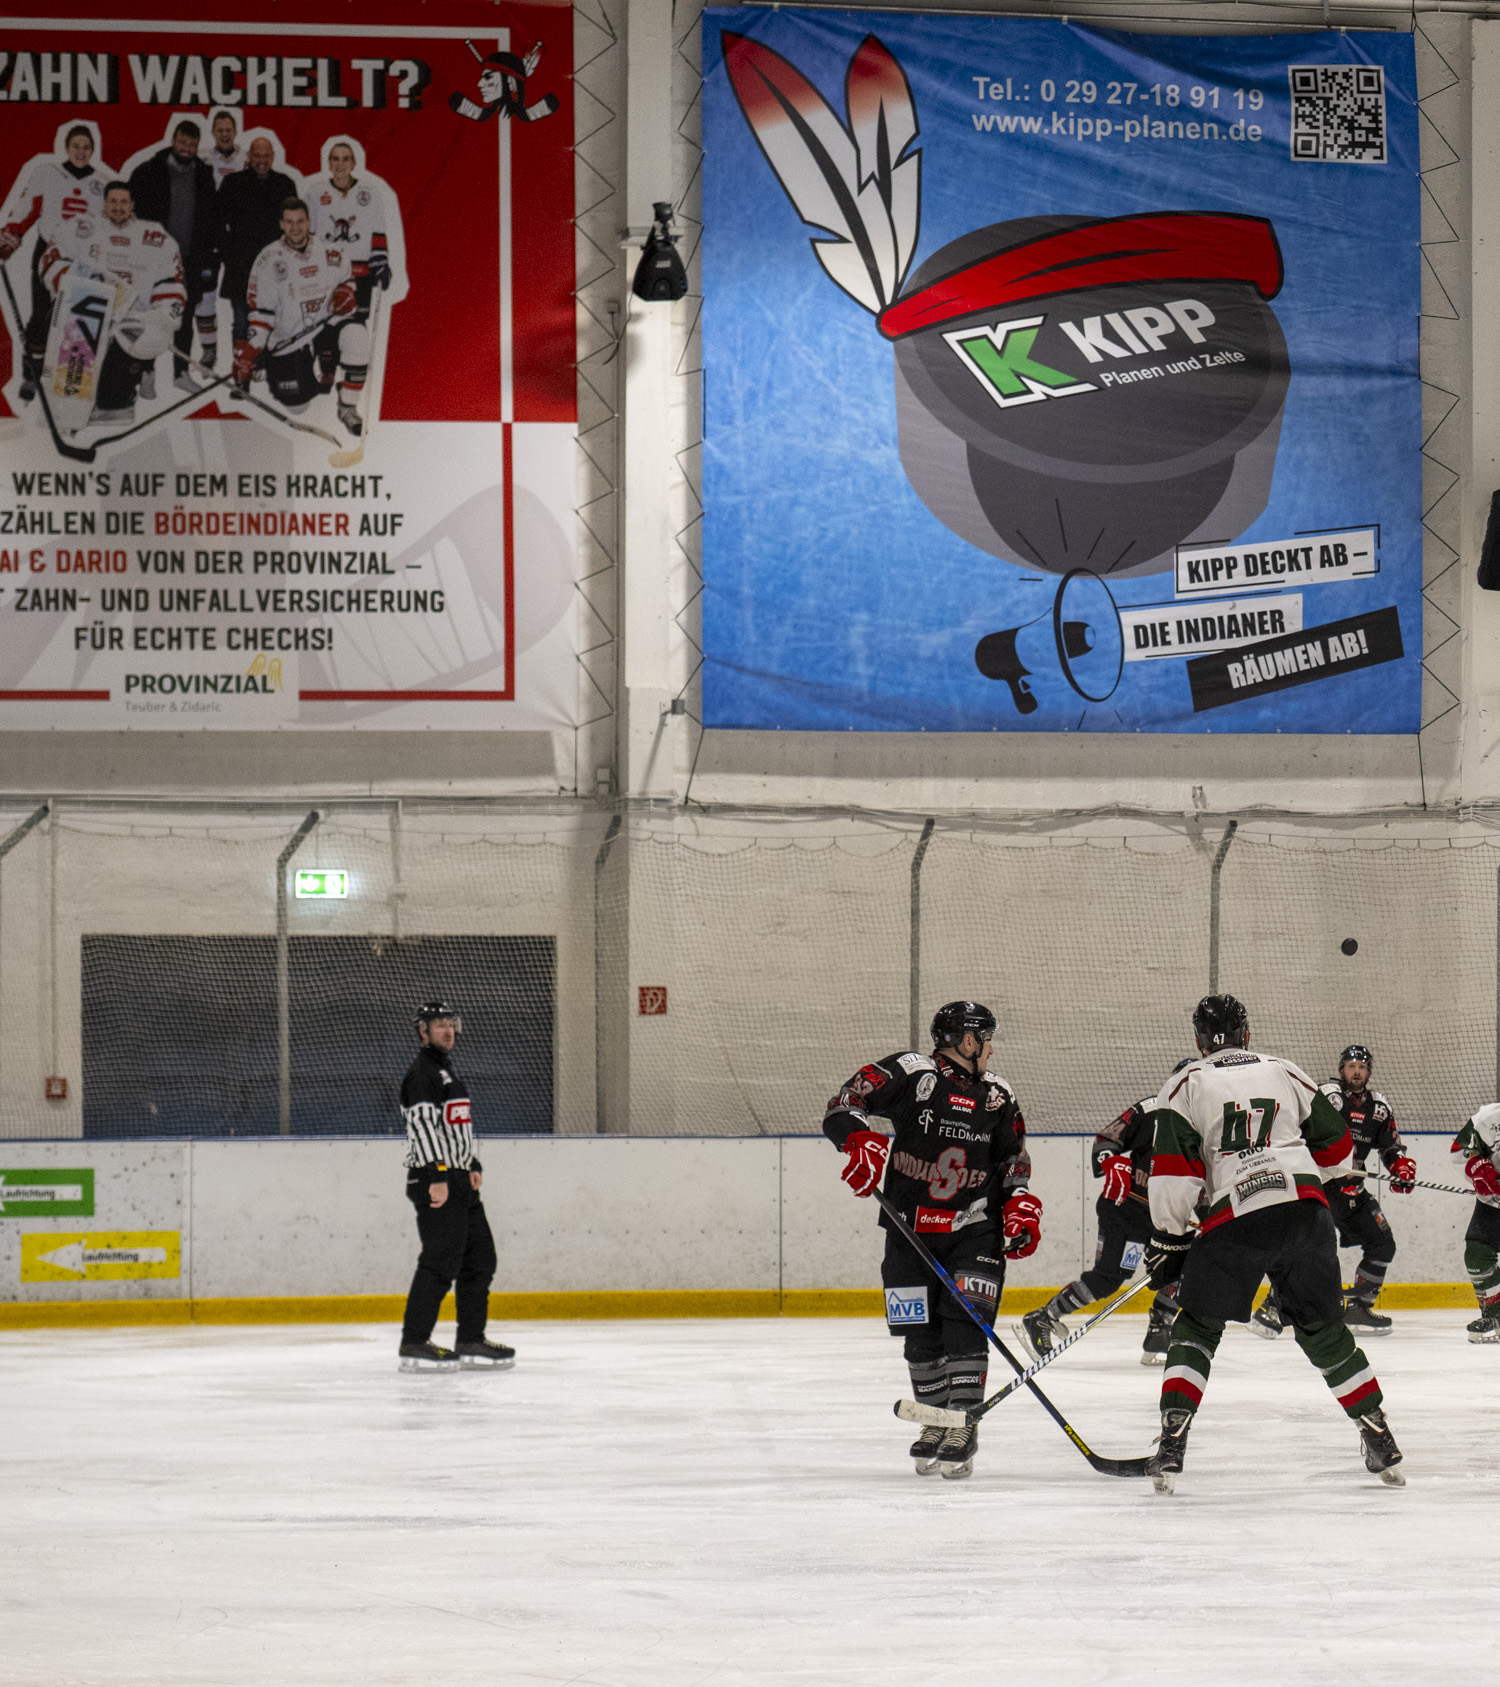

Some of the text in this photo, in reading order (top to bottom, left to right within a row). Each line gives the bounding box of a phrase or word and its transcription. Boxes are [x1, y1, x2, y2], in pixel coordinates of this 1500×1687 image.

[127, 54, 423, 109] WACKELT?
[972, 76, 1264, 112] Tel.: 0 29 27-18 91 19
[971, 110, 1263, 143] www.kipp-planen.de
[1058, 298, 1217, 364] KIPP
[1099, 347, 1247, 389] Planen und Zelte
[119, 473, 165, 498] AUF
[175, 474, 228, 498] DEM
[238, 474, 277, 498] EIS
[286, 475, 392, 501] KRACHT,
[0, 505, 404, 537] ZÄHLEN DIE BÖRDEINDIANER AUF
[29, 551, 46, 573] &
[56, 551, 127, 574] DARIO
[137, 551, 185, 575] VON
[194, 551, 244, 575] DER
[253, 551, 396, 575] PROVINZIAL
[1186, 556, 1239, 584] KIPP
[1244, 547, 1314, 578] DECKT
[1318, 542, 1349, 569] AB
[14, 588, 445, 614] ZAHN- UND UNFALLVERSICHERUNG
[74, 621, 334, 651] FÜR ECHTE CHECKS!
[1133, 609, 1286, 650] DIE INDIANER
[1227, 628, 1370, 690] RÄUMEN AB!
[125, 674, 274, 694] PROVINZIAL
[125, 701, 163, 713] Teuber
[166, 701, 177, 713] &
[1213, 1033, 1226, 1045] 47
[950, 1096, 976, 1107] CCM
[938, 1126, 992, 1143] FELDMANN
[1218, 1097, 1280, 1156] 47
[1236, 1175, 1287, 1200] MINERS
[920, 1215, 951, 1225] decker
[1149, 1237, 1192, 1251] ER-WOOD
[976, 1255, 1000, 1265] CCM
[963, 1276, 998, 1298] KTM
[889, 1302, 925, 1317] MVB
